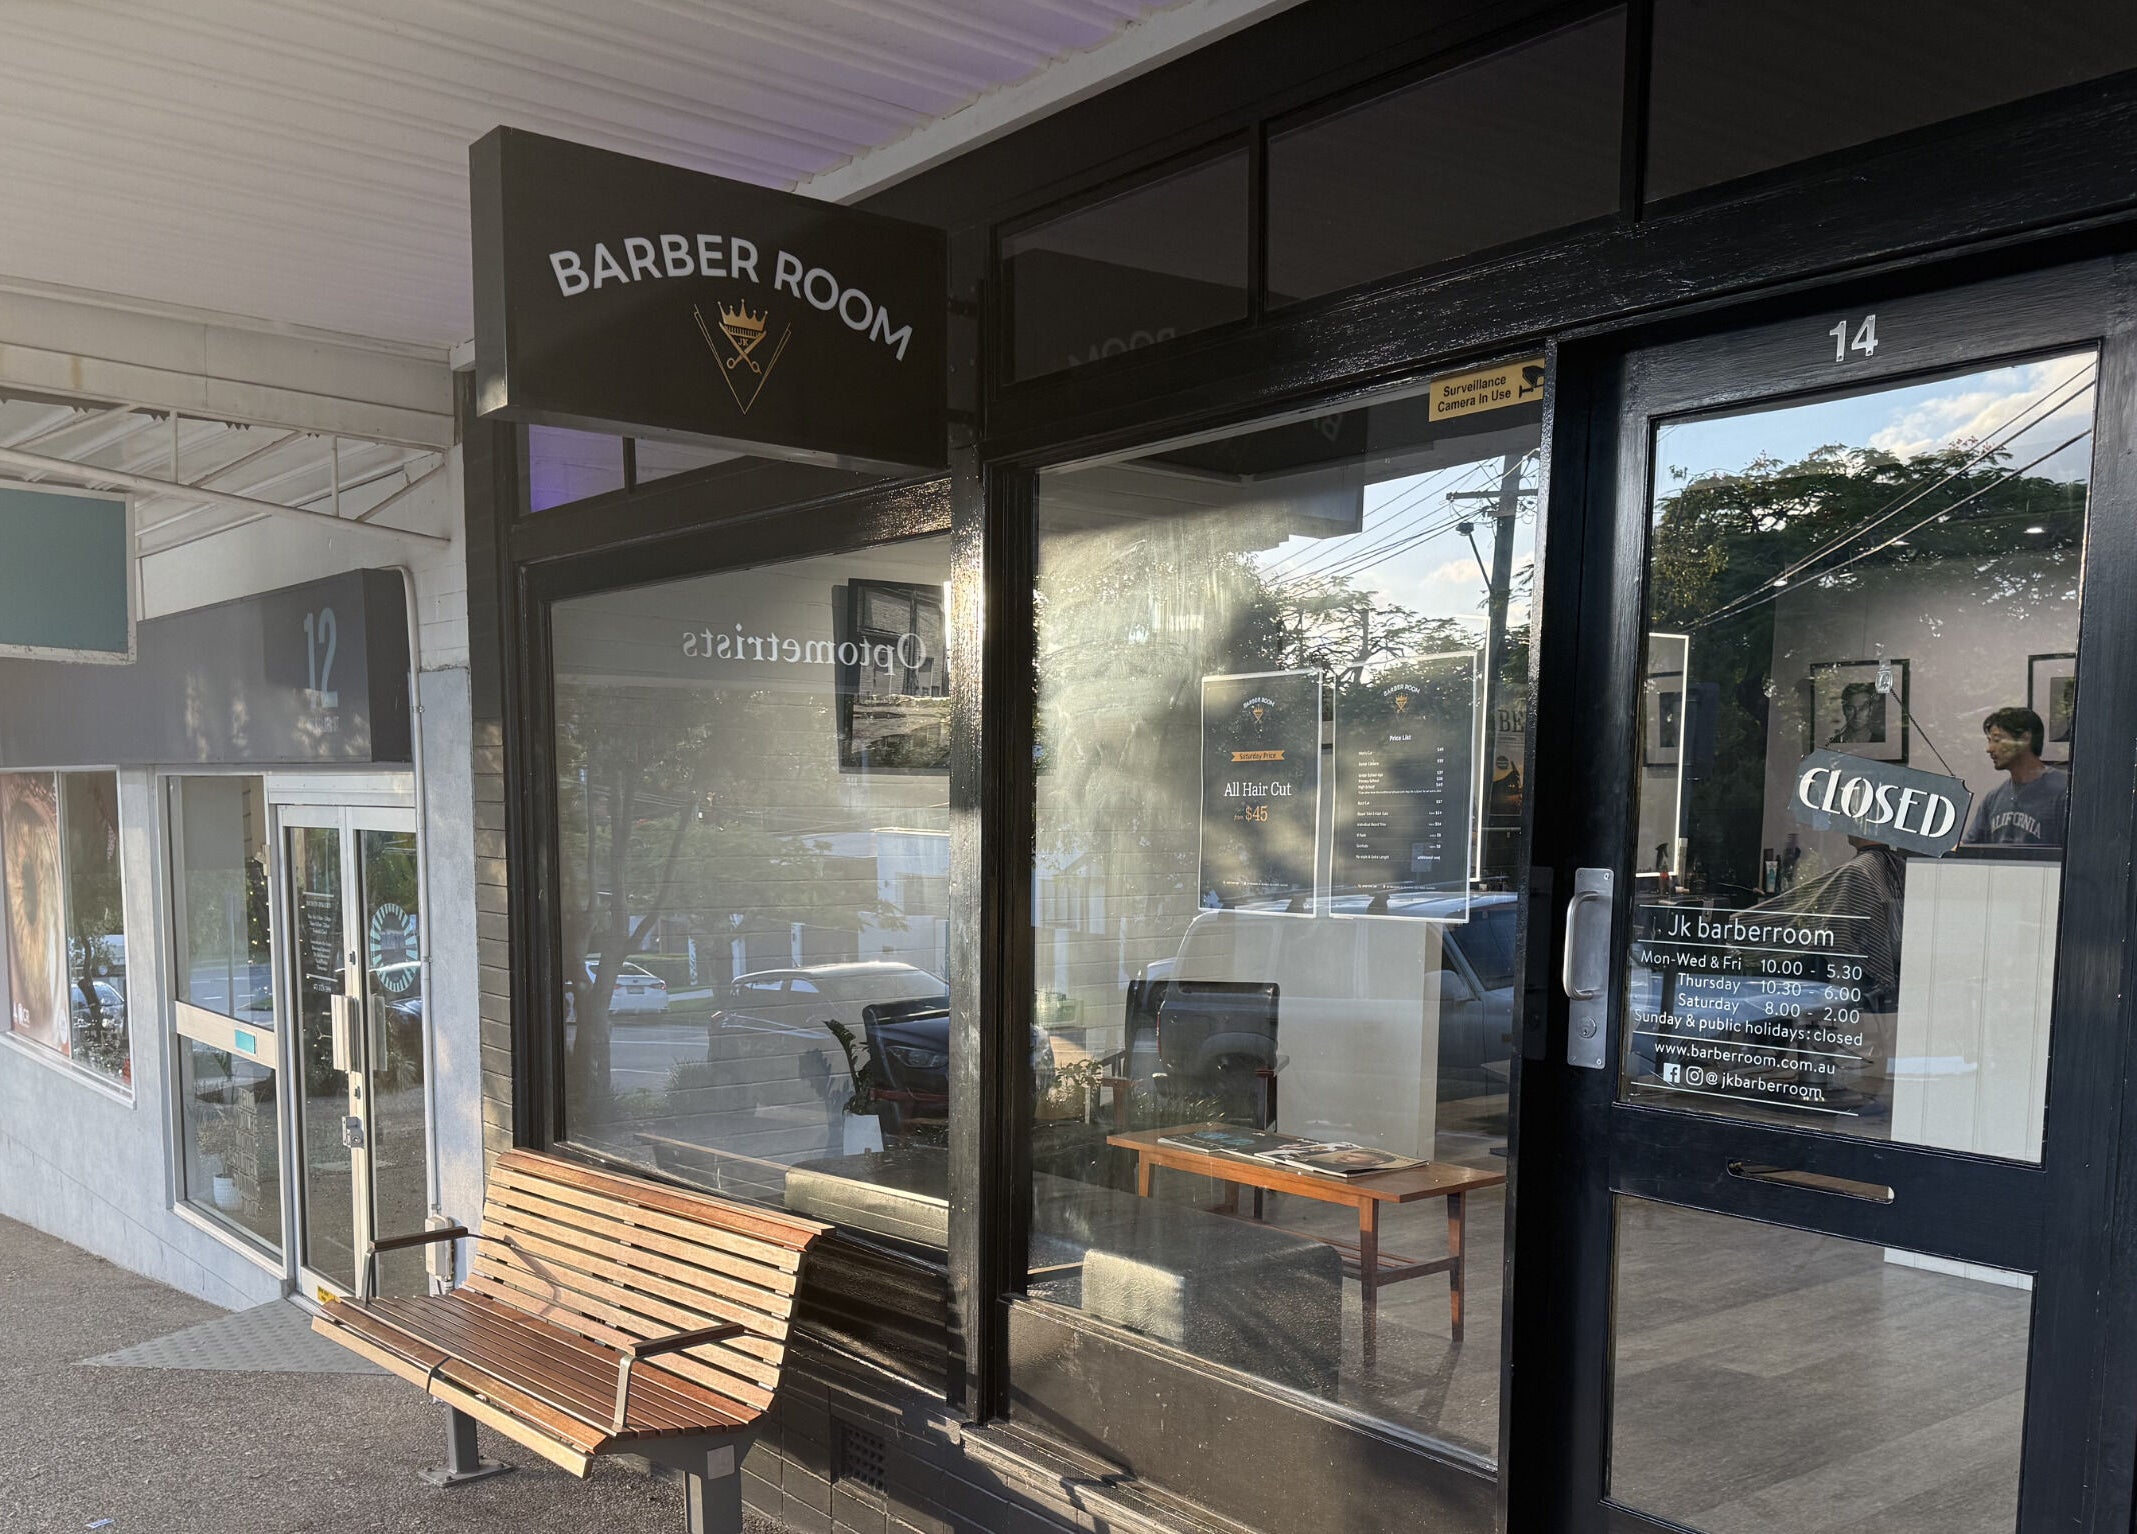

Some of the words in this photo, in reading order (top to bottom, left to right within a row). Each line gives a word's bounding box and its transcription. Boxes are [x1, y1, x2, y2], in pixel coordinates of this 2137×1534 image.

[549, 233, 760, 297] BARBER
[774, 249, 914, 361] ROOM
[1829, 314, 1879, 362] 14
[1438, 396, 1476, 413] Camera
[1479, 393, 1488, 404] In
[1491, 389, 1511, 401] Use
[1443, 375, 1507, 397] Surveillance
[303, 607, 338, 710] 12
[1239, 752, 1263, 760] Saturday
[1224, 781, 1240, 797] All
[1242, 781, 1268, 797] Hair
[1270, 781, 1292, 796] Cut
[1798, 767, 1956, 838] CLOSED
[1245, 805, 1269, 822] $45
[1668, 914, 1691, 937] Jk
[1698, 915, 1834, 947] barberroom
[1640, 950, 1707, 968] Mon-Wed
[1710, 955, 1720, 969] &
[1723, 956, 1742, 971] Fri
[1760, 959, 1803, 975] 10.00
[1826, 964, 1863, 981] 5.30
[1677, 972, 1741, 995] Thursday
[1760, 979, 1802, 996] 10.30
[1824, 985, 1861, 1002] 6.00
[1678, 992, 1740, 1015] Saturday
[1764, 1001, 1801, 1018] 8.00
[1823, 1006, 1860, 1024] 2.00
[1634, 1008, 1682, 1029] Sunday
[1685, 1013, 1696, 1028] &
[1698, 1017, 1742, 1032] public
[1813, 1028, 1863, 1046] closed
[1654, 1043, 1836, 1075] www.barberroom.com.au
